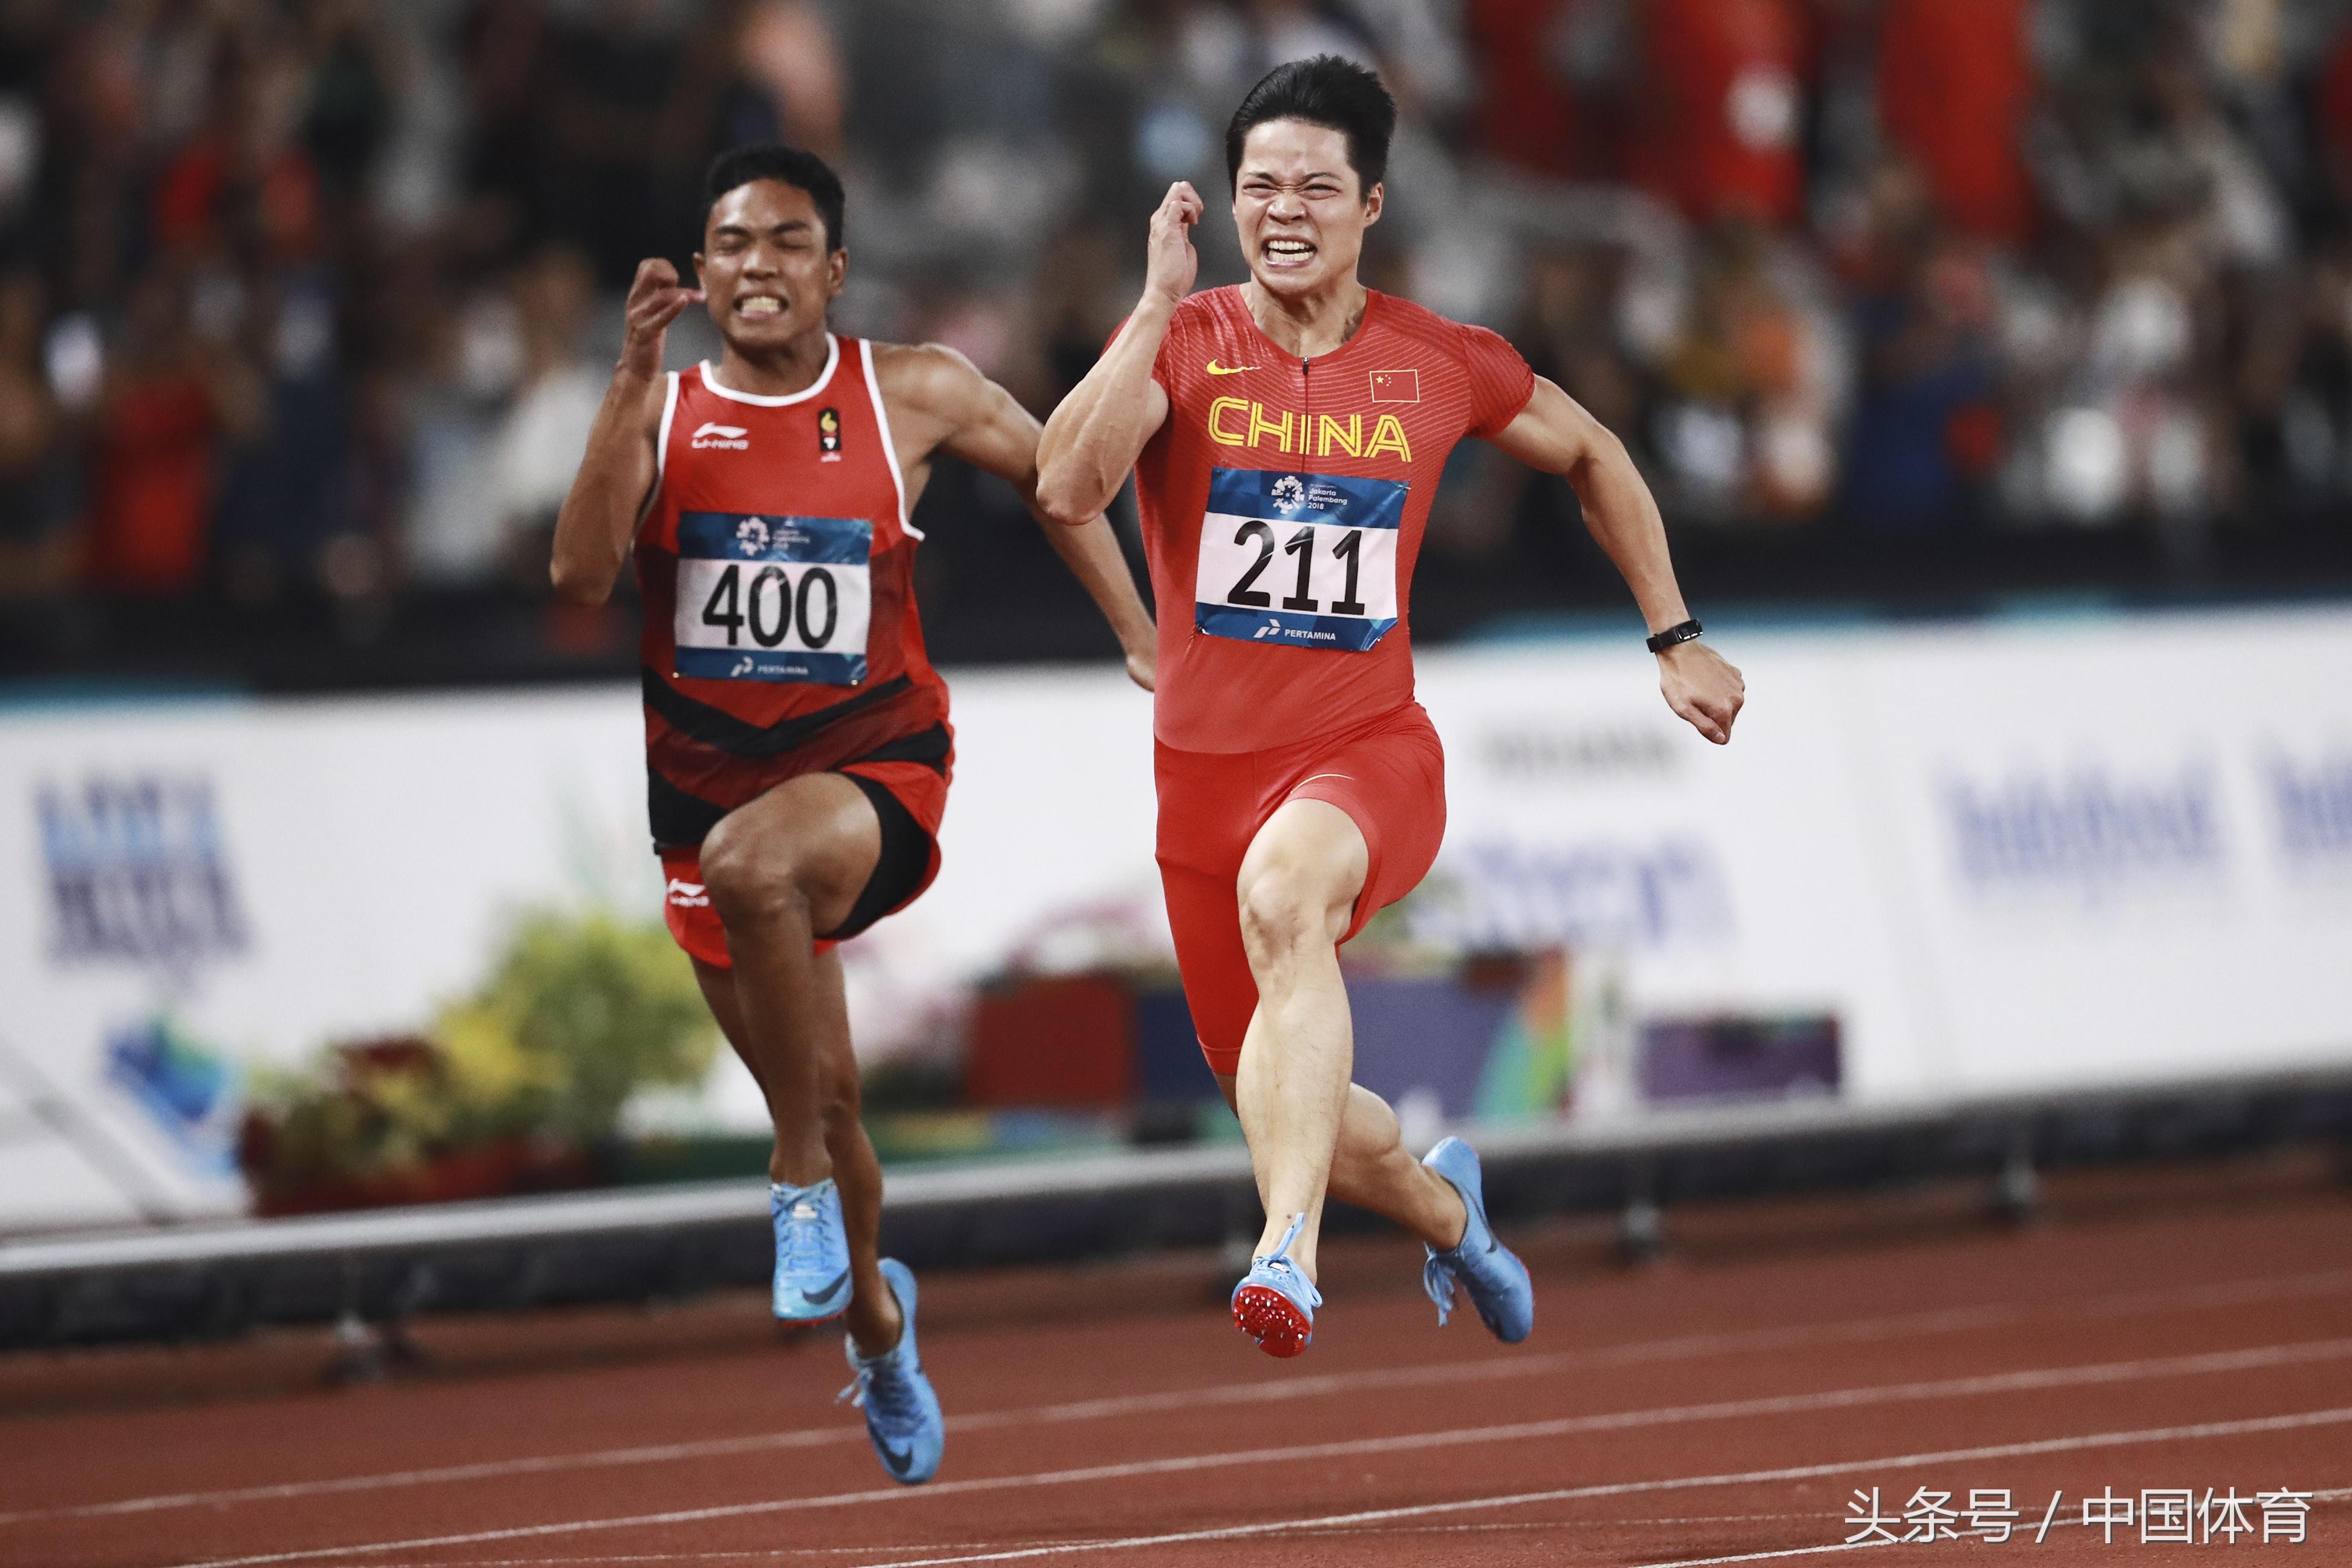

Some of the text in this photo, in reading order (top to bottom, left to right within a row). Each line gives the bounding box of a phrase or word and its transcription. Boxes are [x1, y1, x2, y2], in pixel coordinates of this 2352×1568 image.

[1208, 396, 1412, 463] CHINA
[1308, 494, 1348, 506] Palembang
[1227, 520, 1365, 616] 211
[702, 564, 838, 650] 400
[1284, 629, 1336, 641] PERTAMINA
